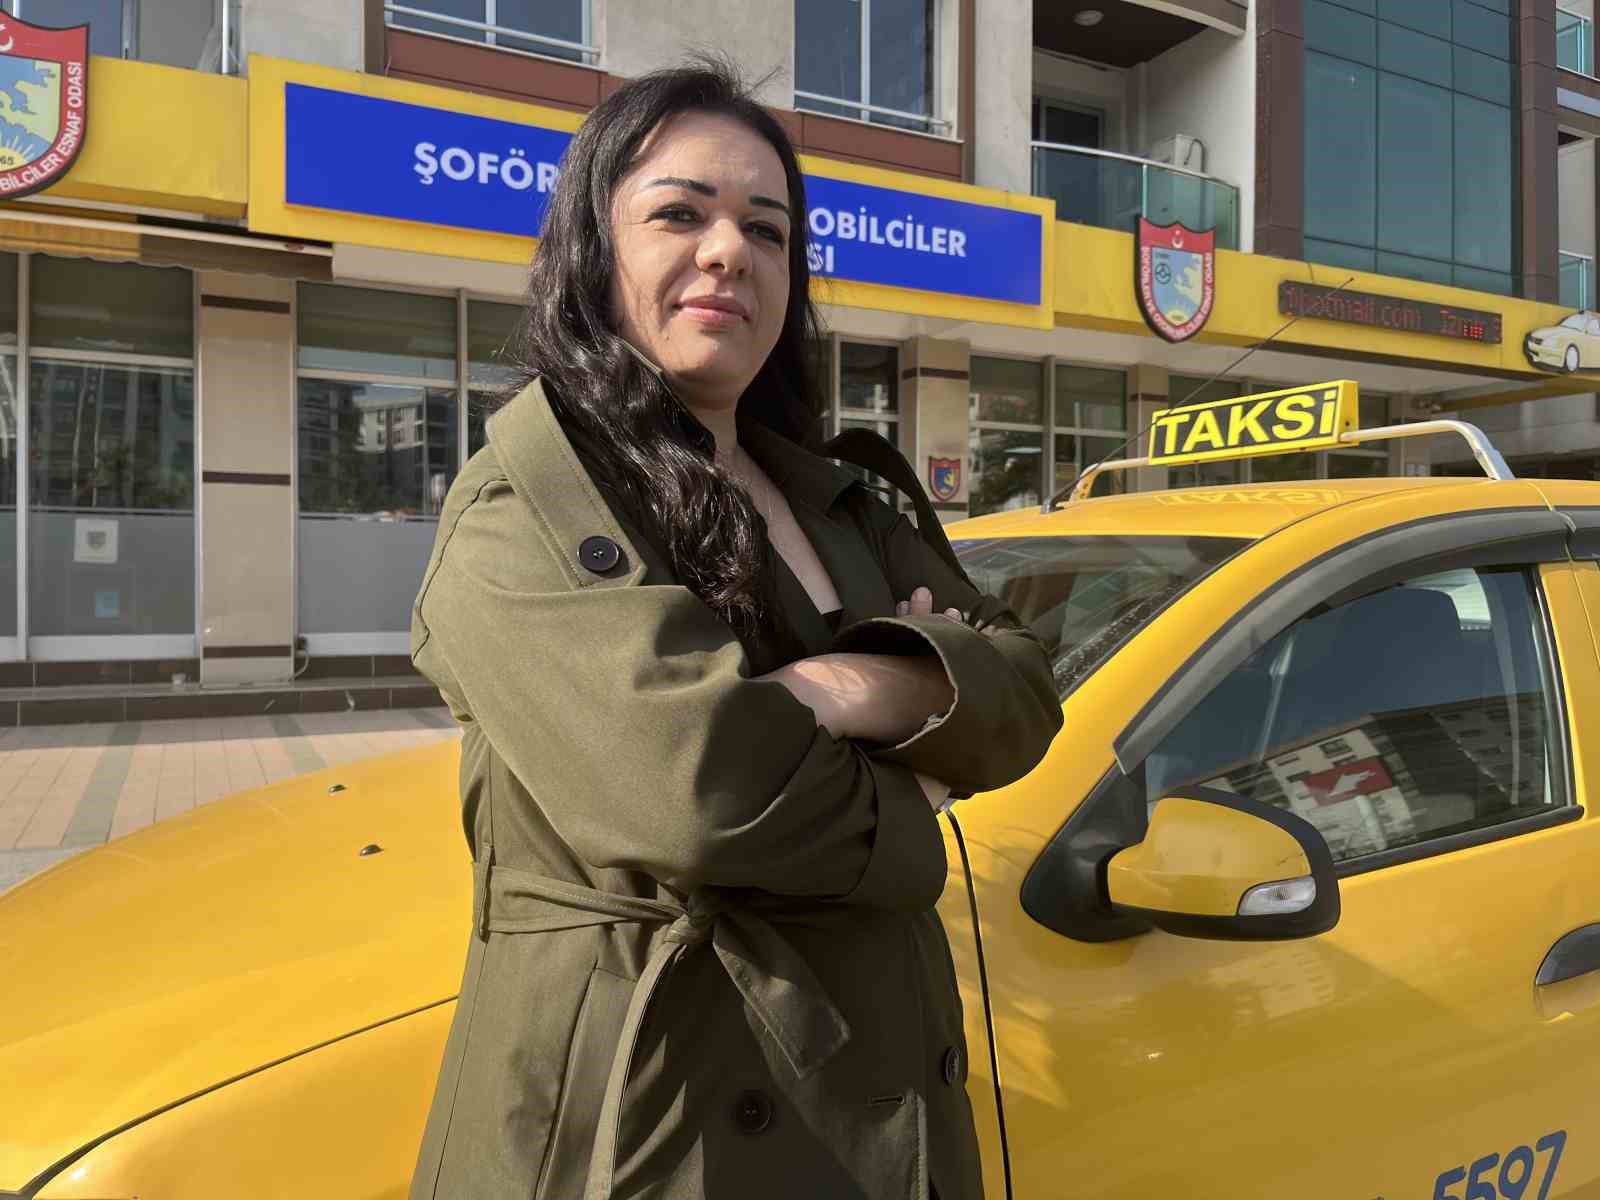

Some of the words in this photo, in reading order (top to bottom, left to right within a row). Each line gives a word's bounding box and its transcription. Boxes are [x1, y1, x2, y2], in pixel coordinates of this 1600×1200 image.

[68, 62, 82, 107] ODASI
[58, 110, 82, 155] ESNAF
[0, 153, 63, 191] BİLCİLER
[413, 141, 562, 193] ŞOFÖR
[806, 206, 967, 258] OBİLCİLER
[806, 243, 834, 274] SI
